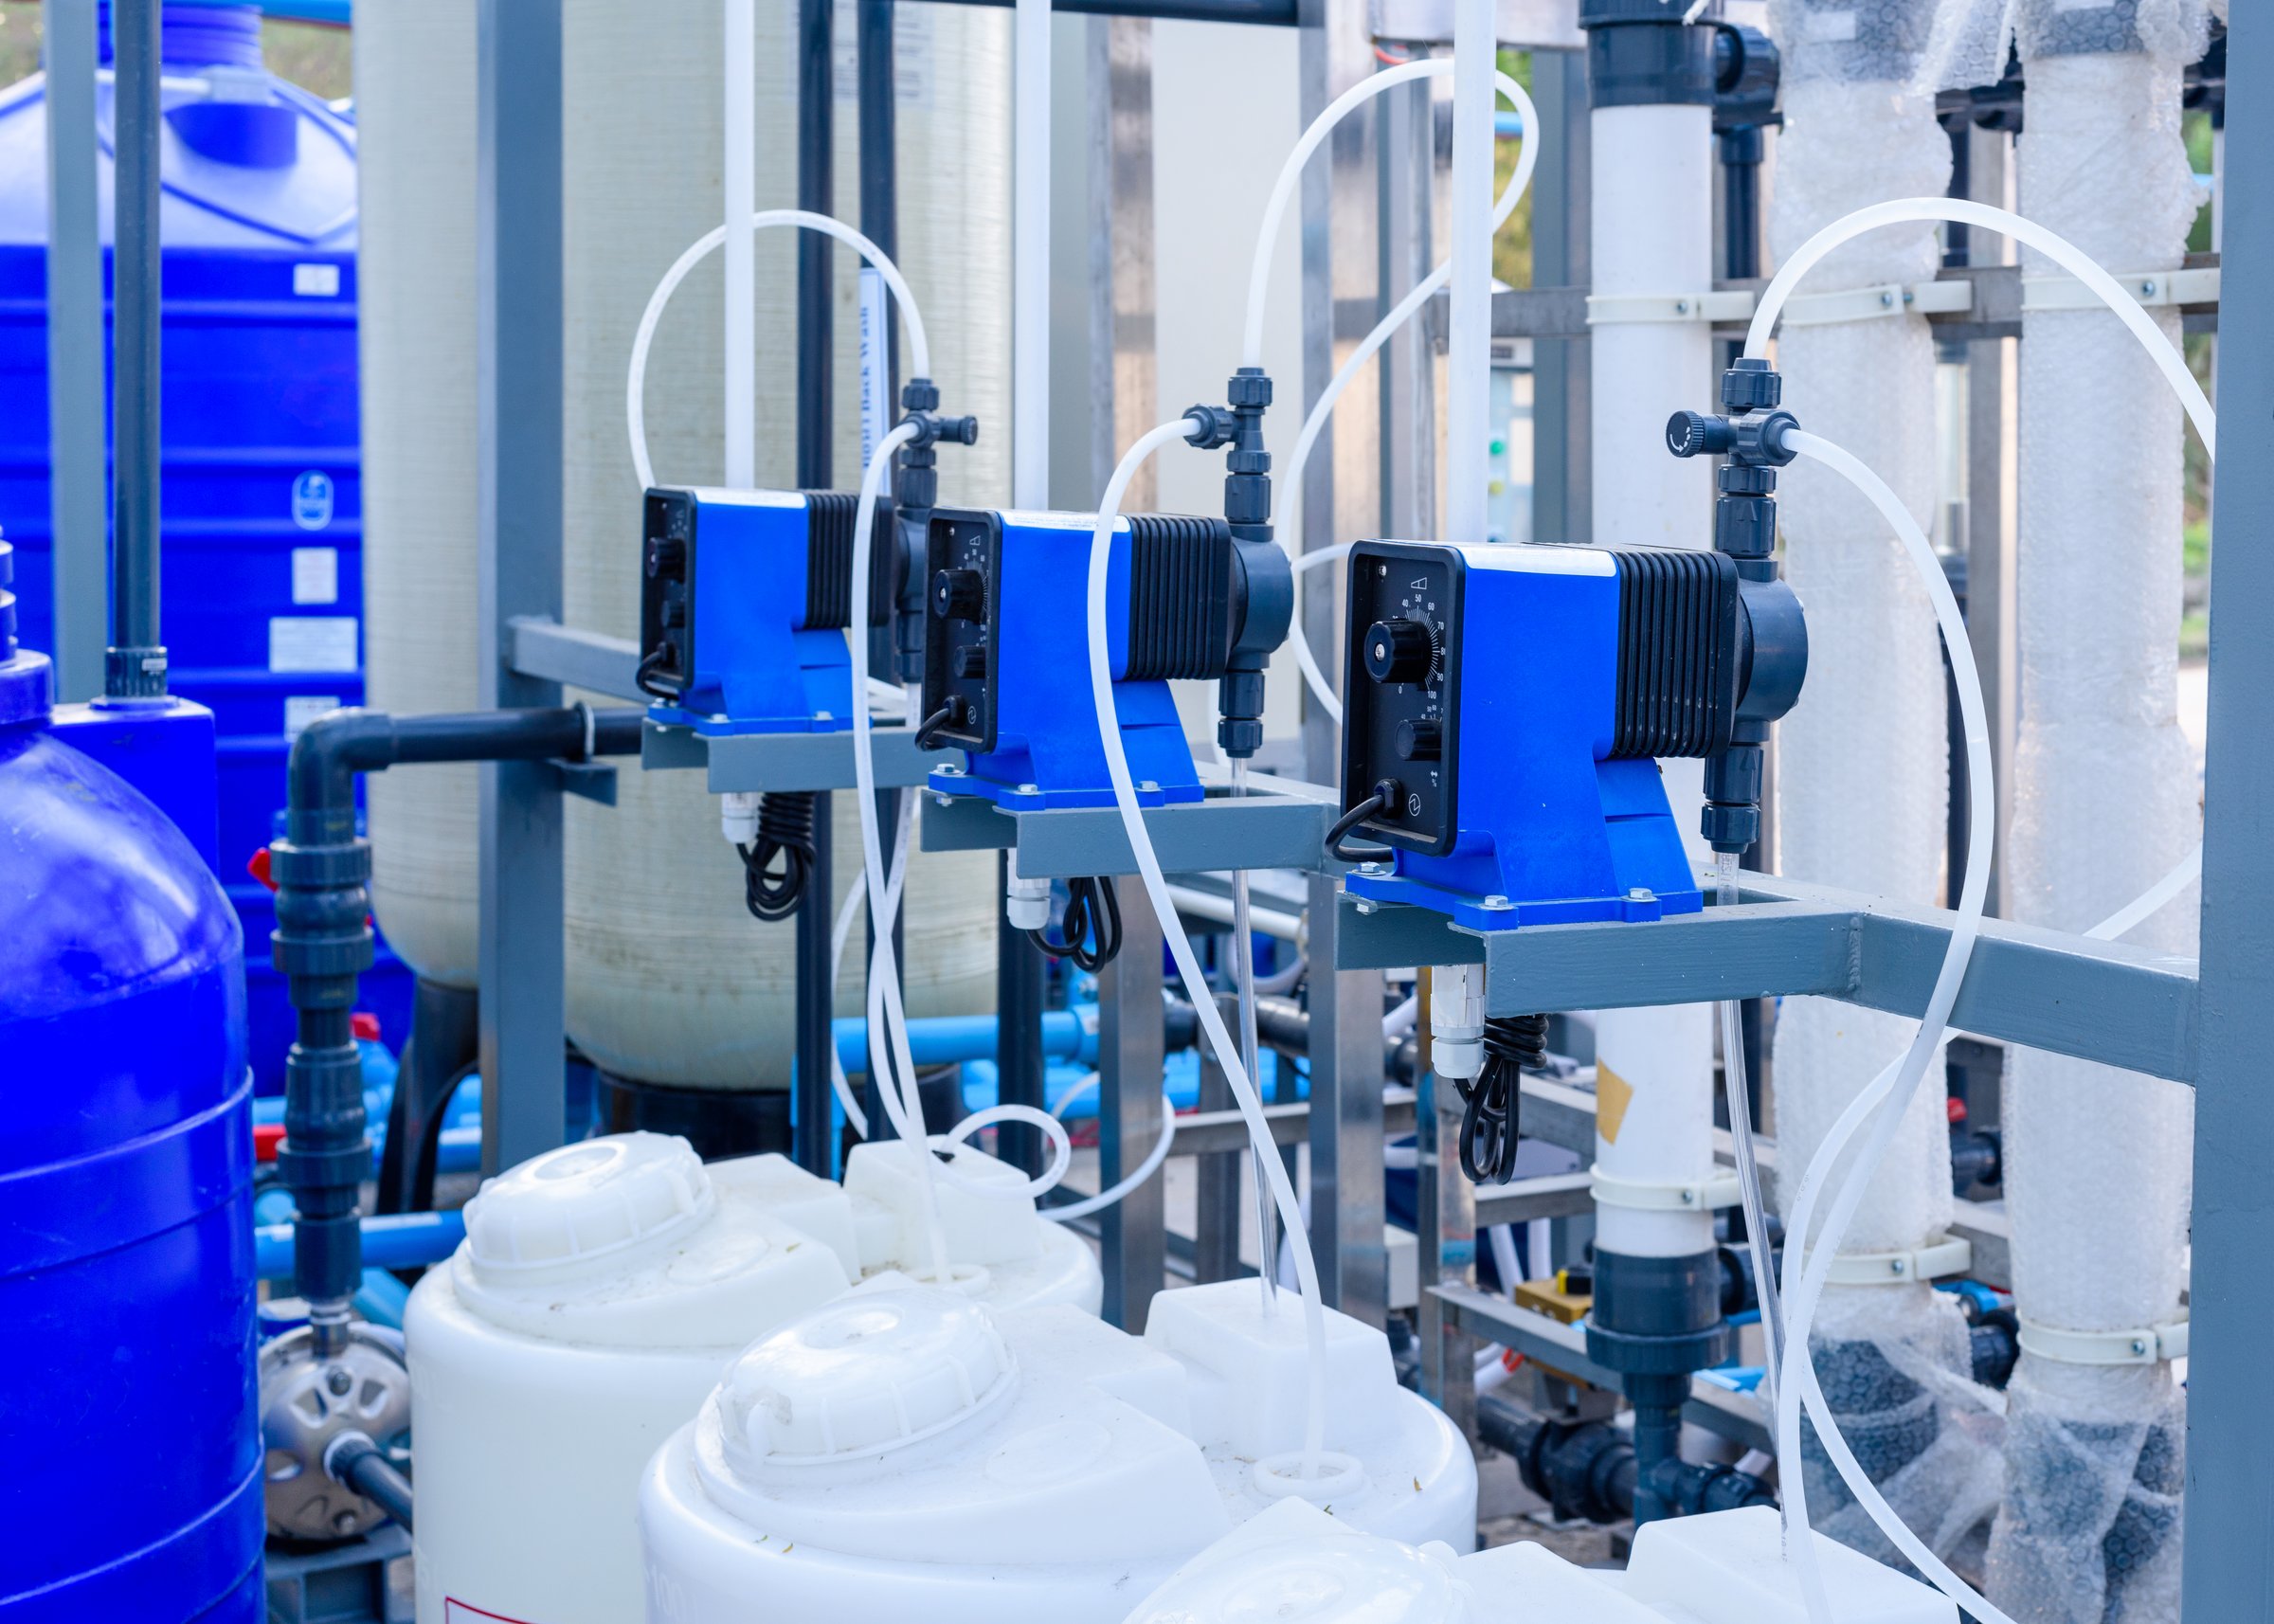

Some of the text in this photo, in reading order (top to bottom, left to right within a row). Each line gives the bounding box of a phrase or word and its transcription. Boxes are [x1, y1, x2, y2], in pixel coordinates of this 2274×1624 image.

[1415, 593, 1421, 603] 50
[1402, 599, 1409, 607] 40
[1428, 602, 1435, 611] 60
[1437, 621, 1444, 630] 70
[1436, 673, 1444, 681] 90
[1398, 685, 1402, 695] 0
[1427, 691, 1436, 699] 100
